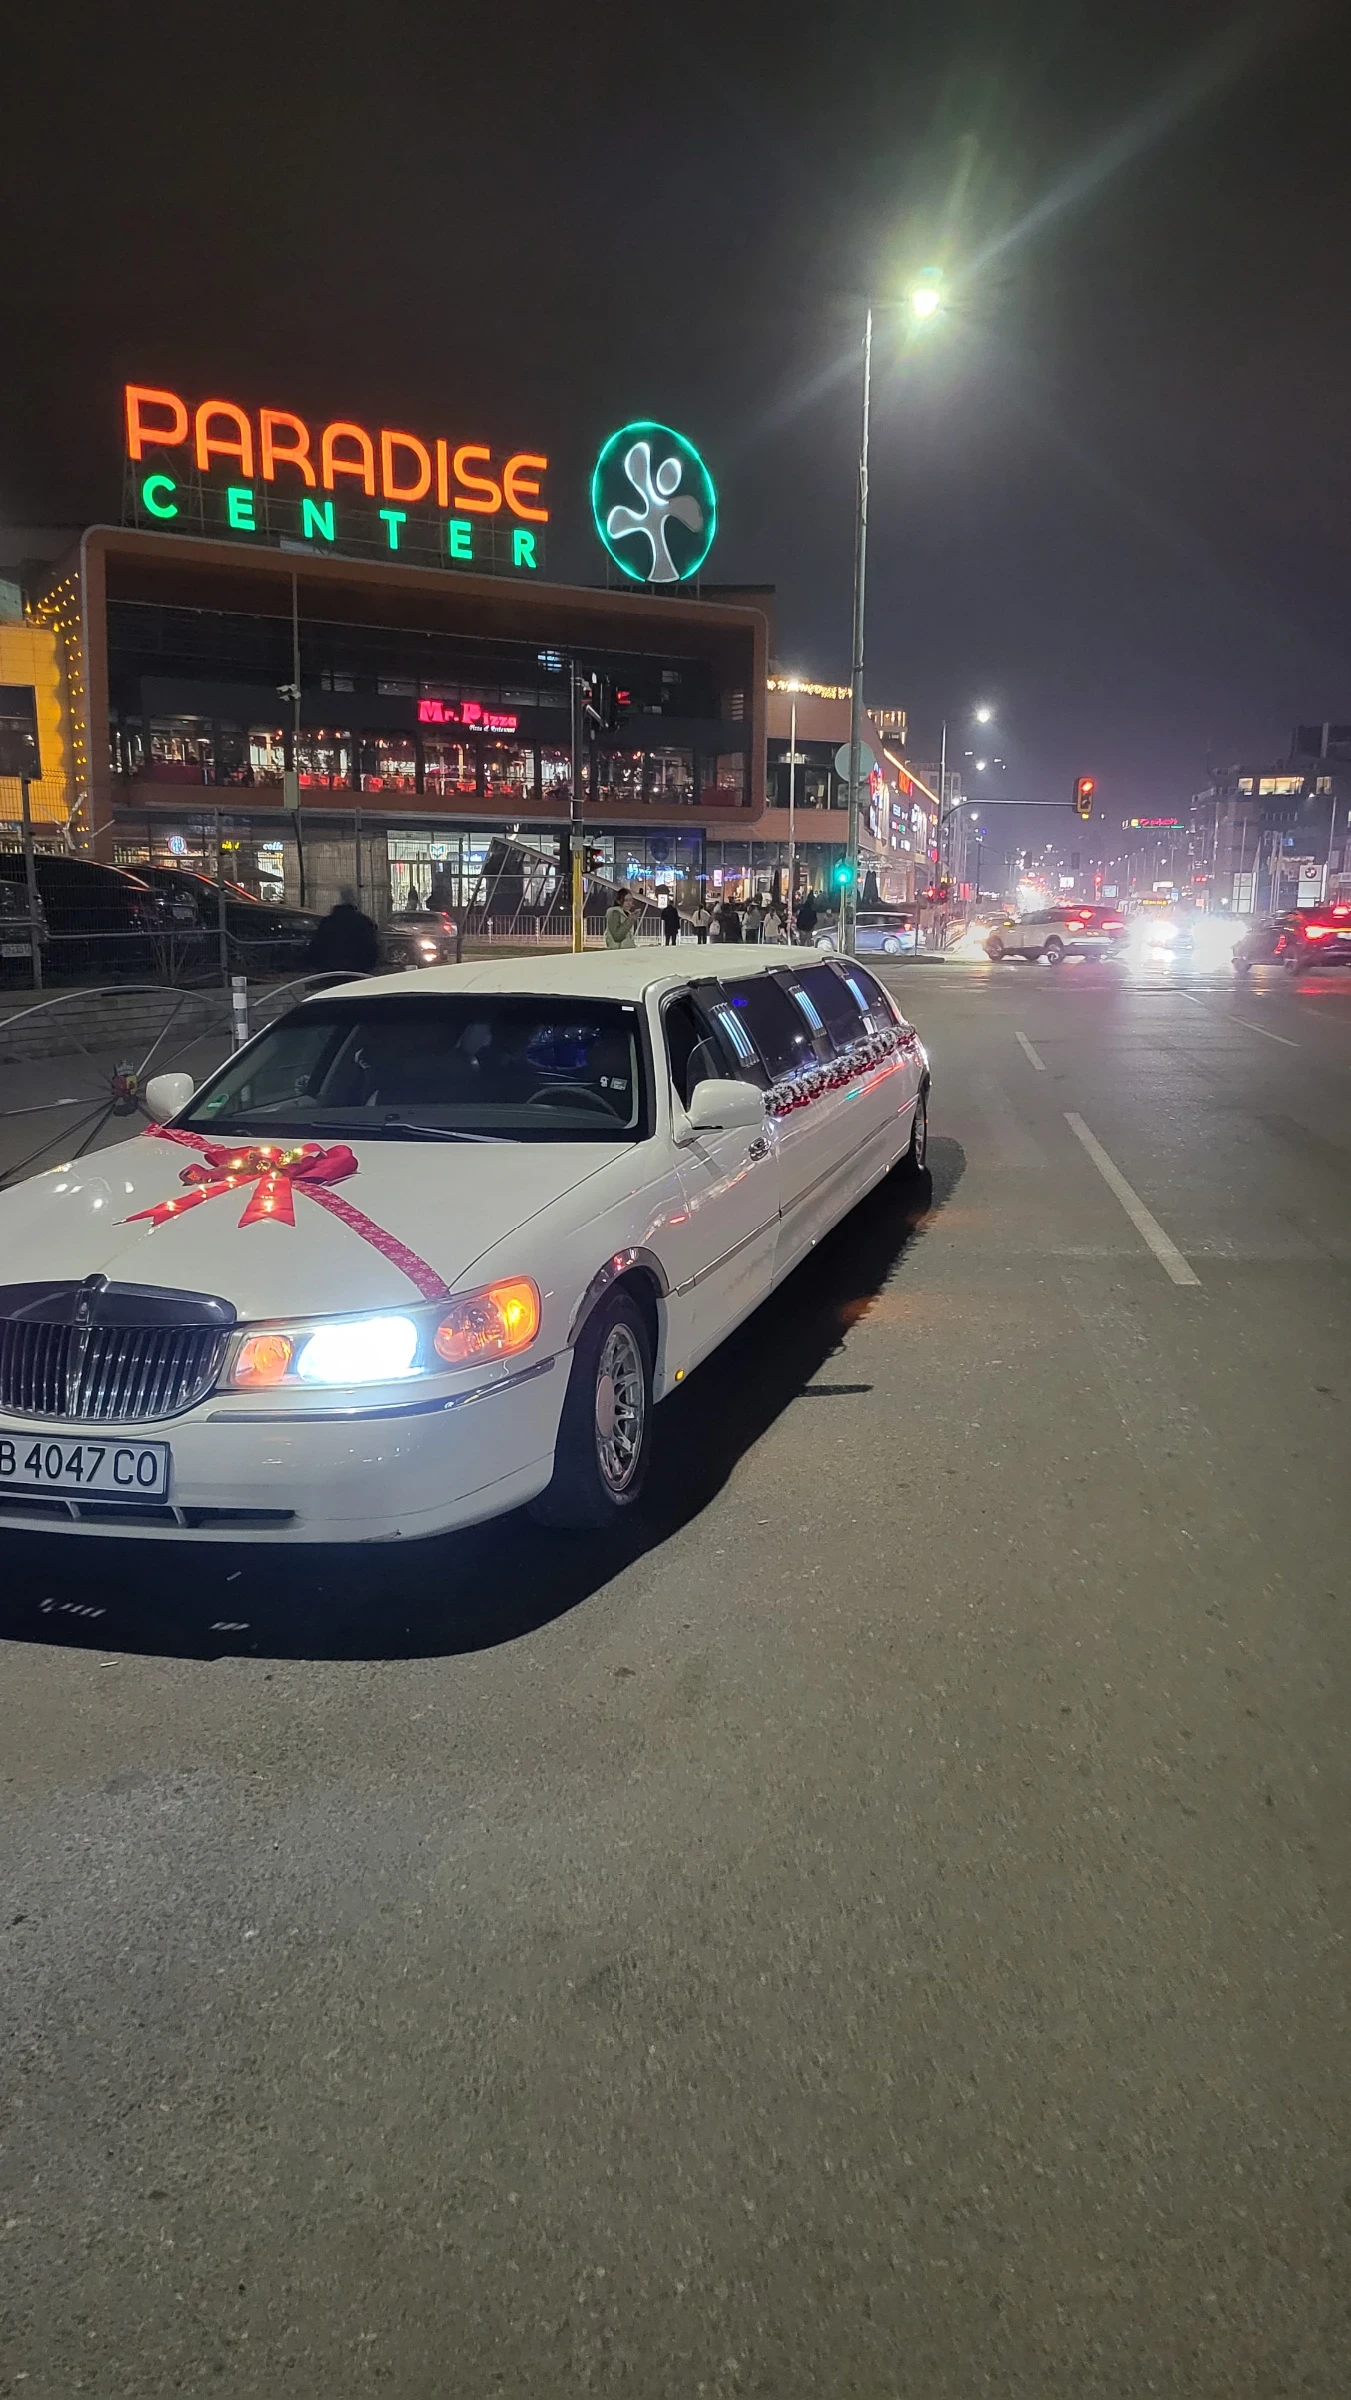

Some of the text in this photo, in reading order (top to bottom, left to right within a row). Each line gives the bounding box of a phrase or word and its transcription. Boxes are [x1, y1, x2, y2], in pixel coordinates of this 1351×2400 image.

[125, 385, 549, 522] PARADISE
[142, 475, 537, 569] CENTER
[418, 700, 518, 727] Mr. Pizza
[25, 1443, 106, 1482] 4047
[113, 1449, 158, 1487] CO
